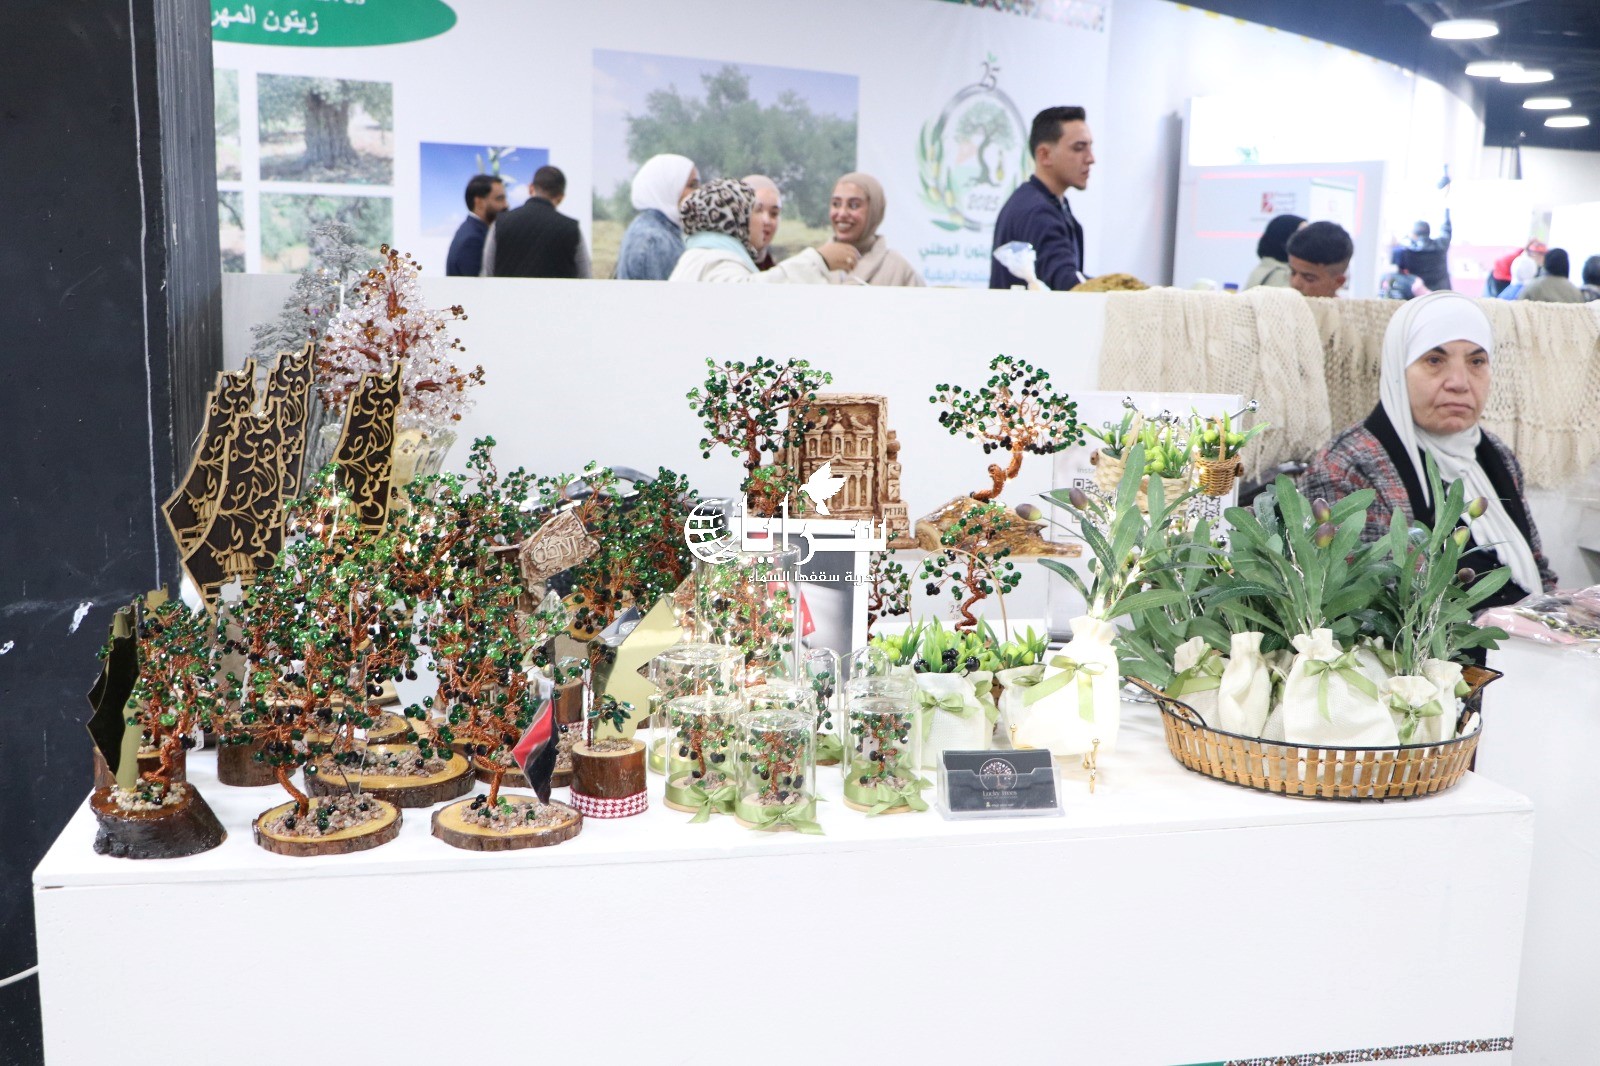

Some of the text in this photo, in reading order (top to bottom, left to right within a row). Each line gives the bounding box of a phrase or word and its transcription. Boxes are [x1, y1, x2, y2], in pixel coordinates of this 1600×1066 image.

[211, 4, 319, 35] زيتون المهر
[979, 61, 1000, 91] 25
[884, 506, 908, 516] PETRA
